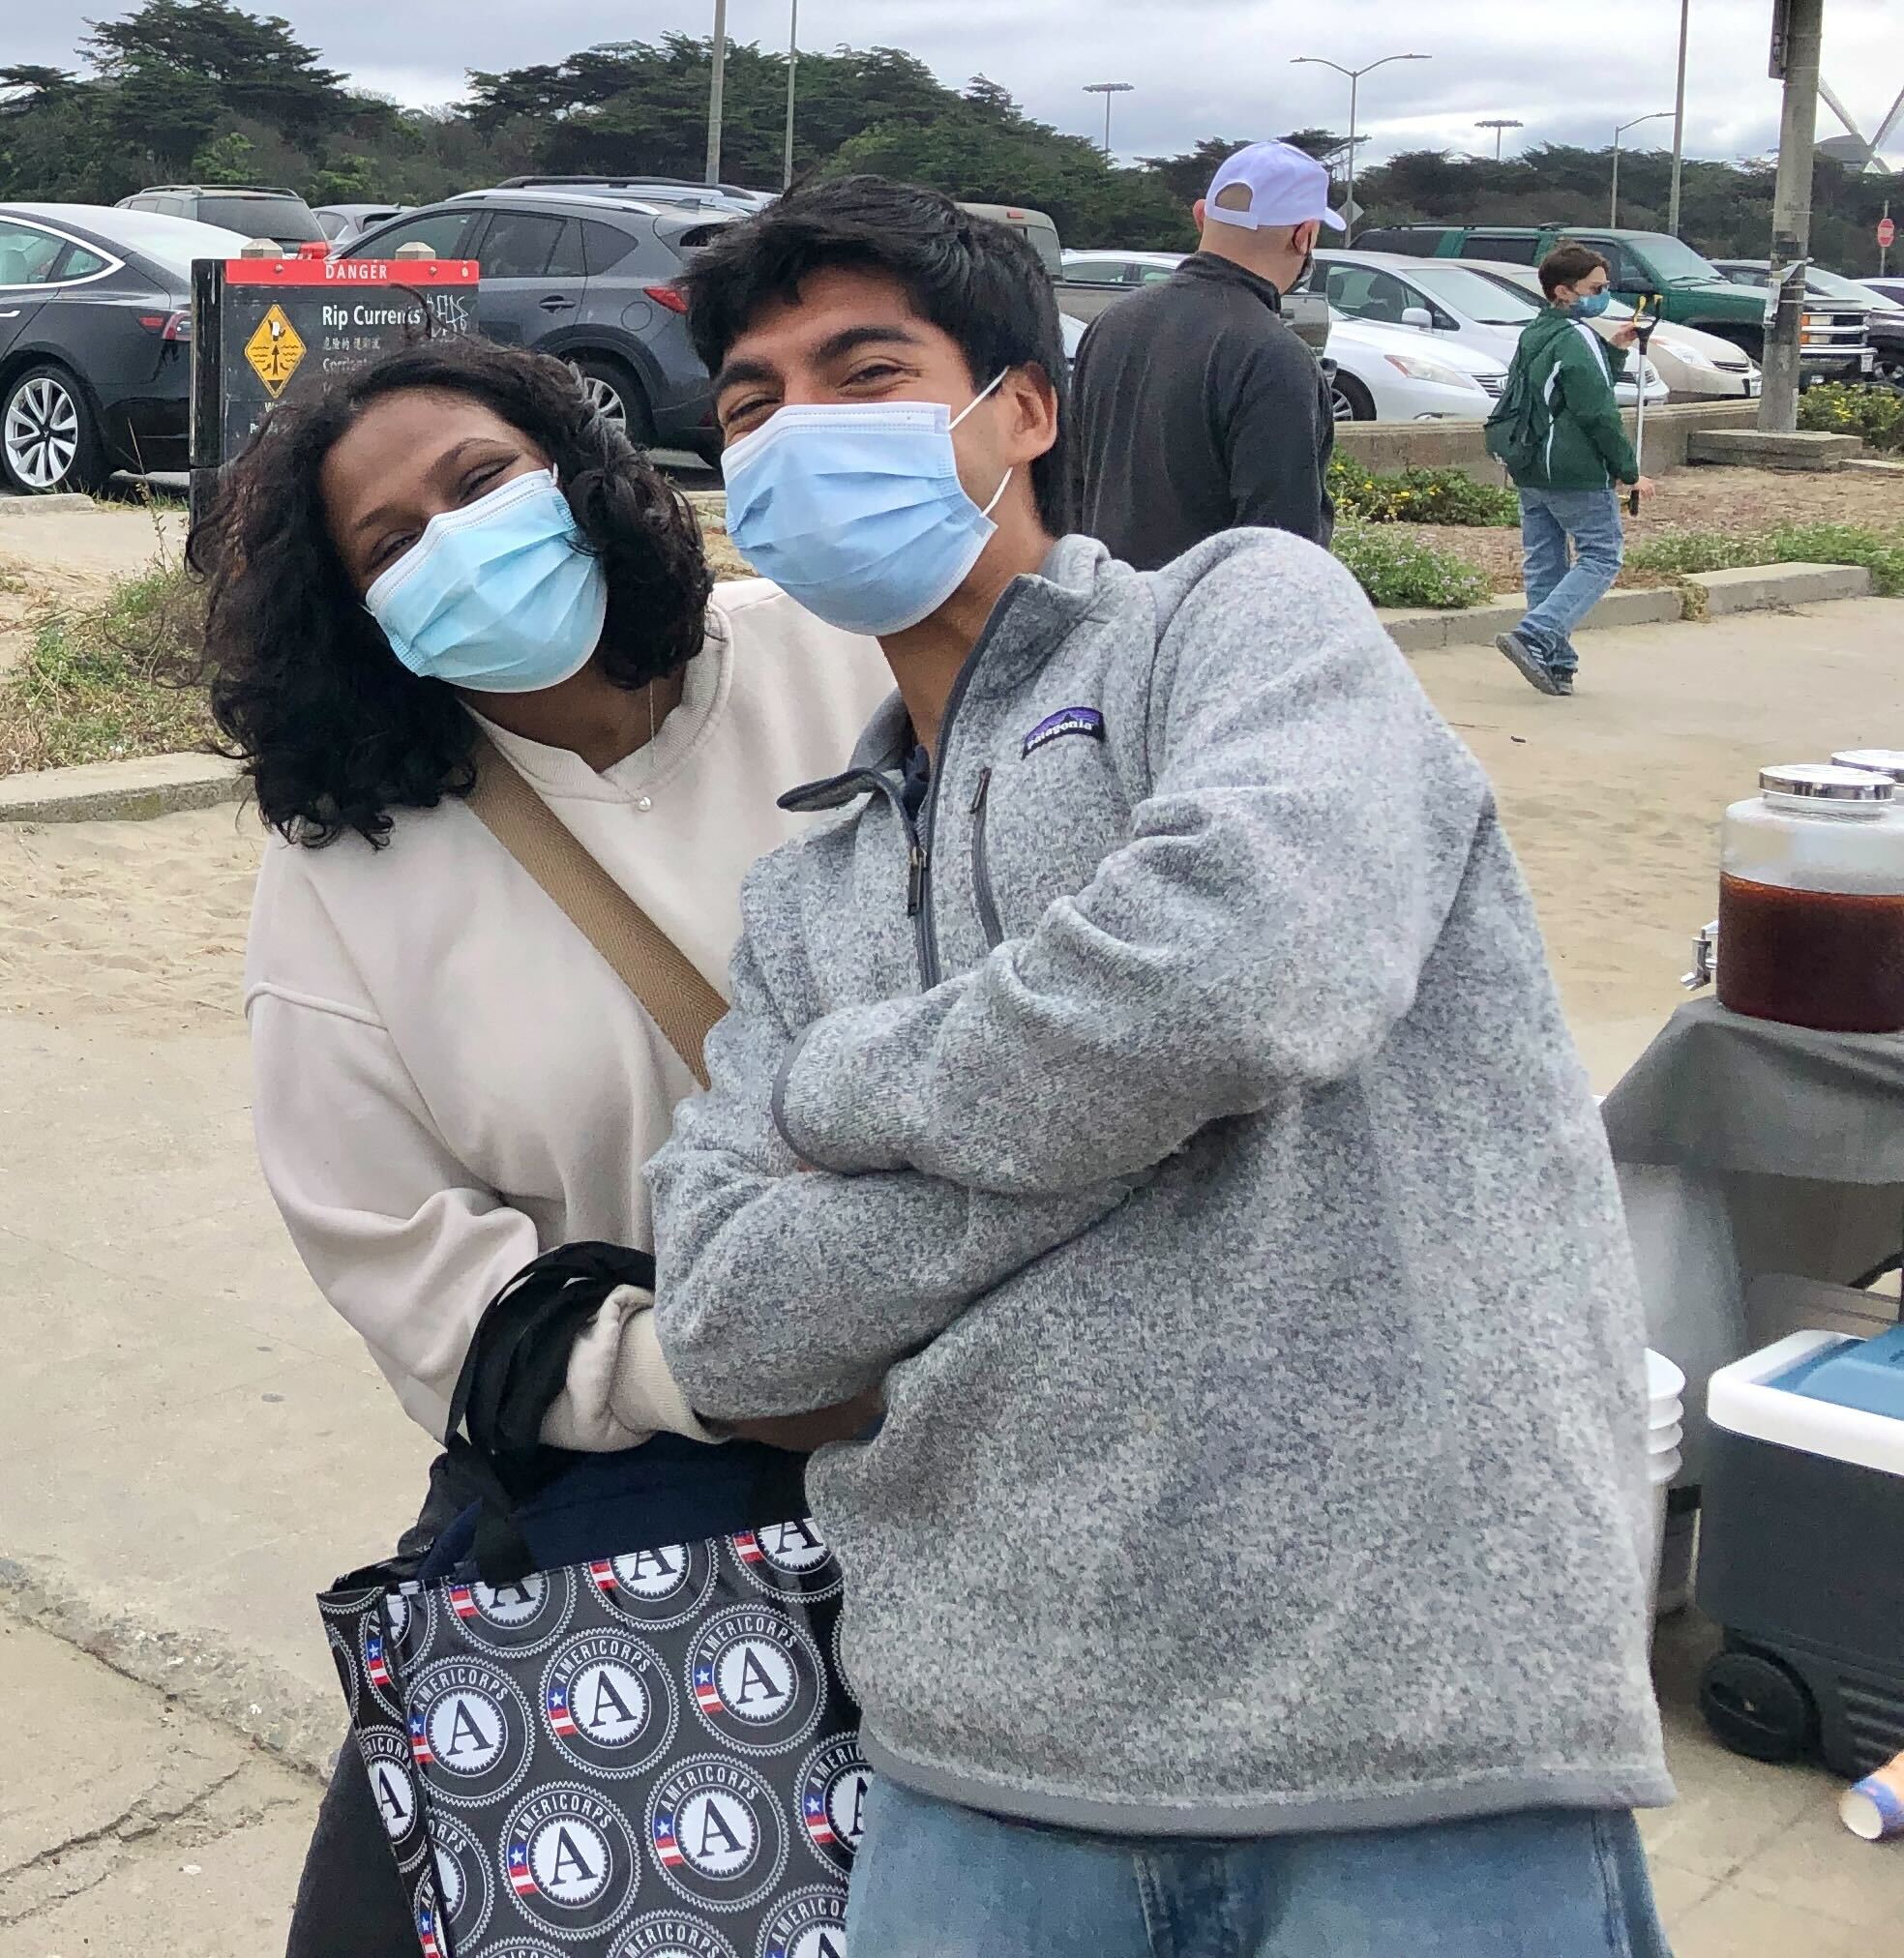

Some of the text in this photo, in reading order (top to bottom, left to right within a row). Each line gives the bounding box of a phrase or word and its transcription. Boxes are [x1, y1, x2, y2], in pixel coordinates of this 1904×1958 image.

[325, 264, 388, 280] DANGER
[322, 304, 349, 331] Rip
[553, 1639, 650, 1684] AMERICORPS
[700, 1617, 797, 1661] AMERICORPS
[413, 1668, 509, 1711] AMERICORPS
[736, 1646, 786, 1705] A
[589, 1670, 638, 1728] A
[446, 1699, 494, 1757] A
[661, 1766, 759, 1812] AMERICORPS
[810, 1744, 864, 1790] AMERIC
[515, 1795, 612, 1840] AMERICORPS
[697, 1797, 747, 1857] A
[549, 1825, 599, 1886] A
[624, 1923, 720, 1958] MERICORPS
[771, 1897, 848, 1946] AMERICO
